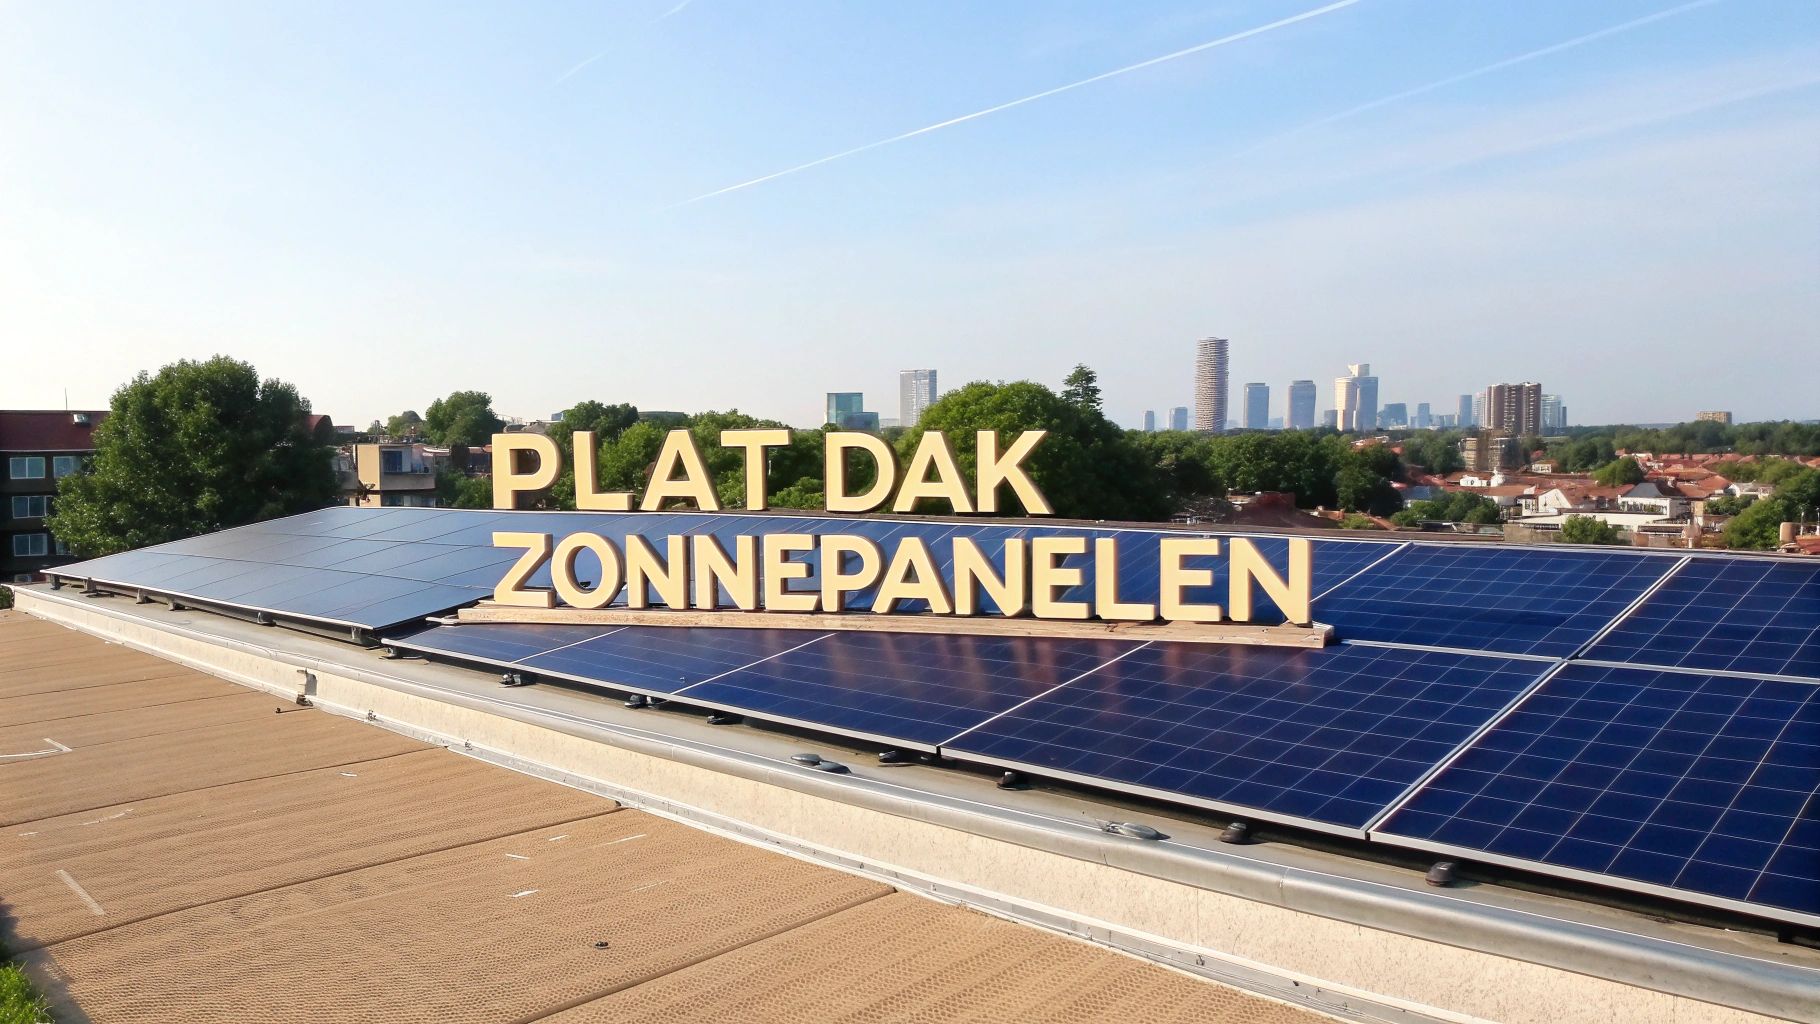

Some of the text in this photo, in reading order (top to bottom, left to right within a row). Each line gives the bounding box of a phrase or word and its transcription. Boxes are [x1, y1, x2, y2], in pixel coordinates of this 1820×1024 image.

[491, 429, 1052, 515] PLAT DAK
[492, 531, 1313, 625] ZONNEPANELEN
